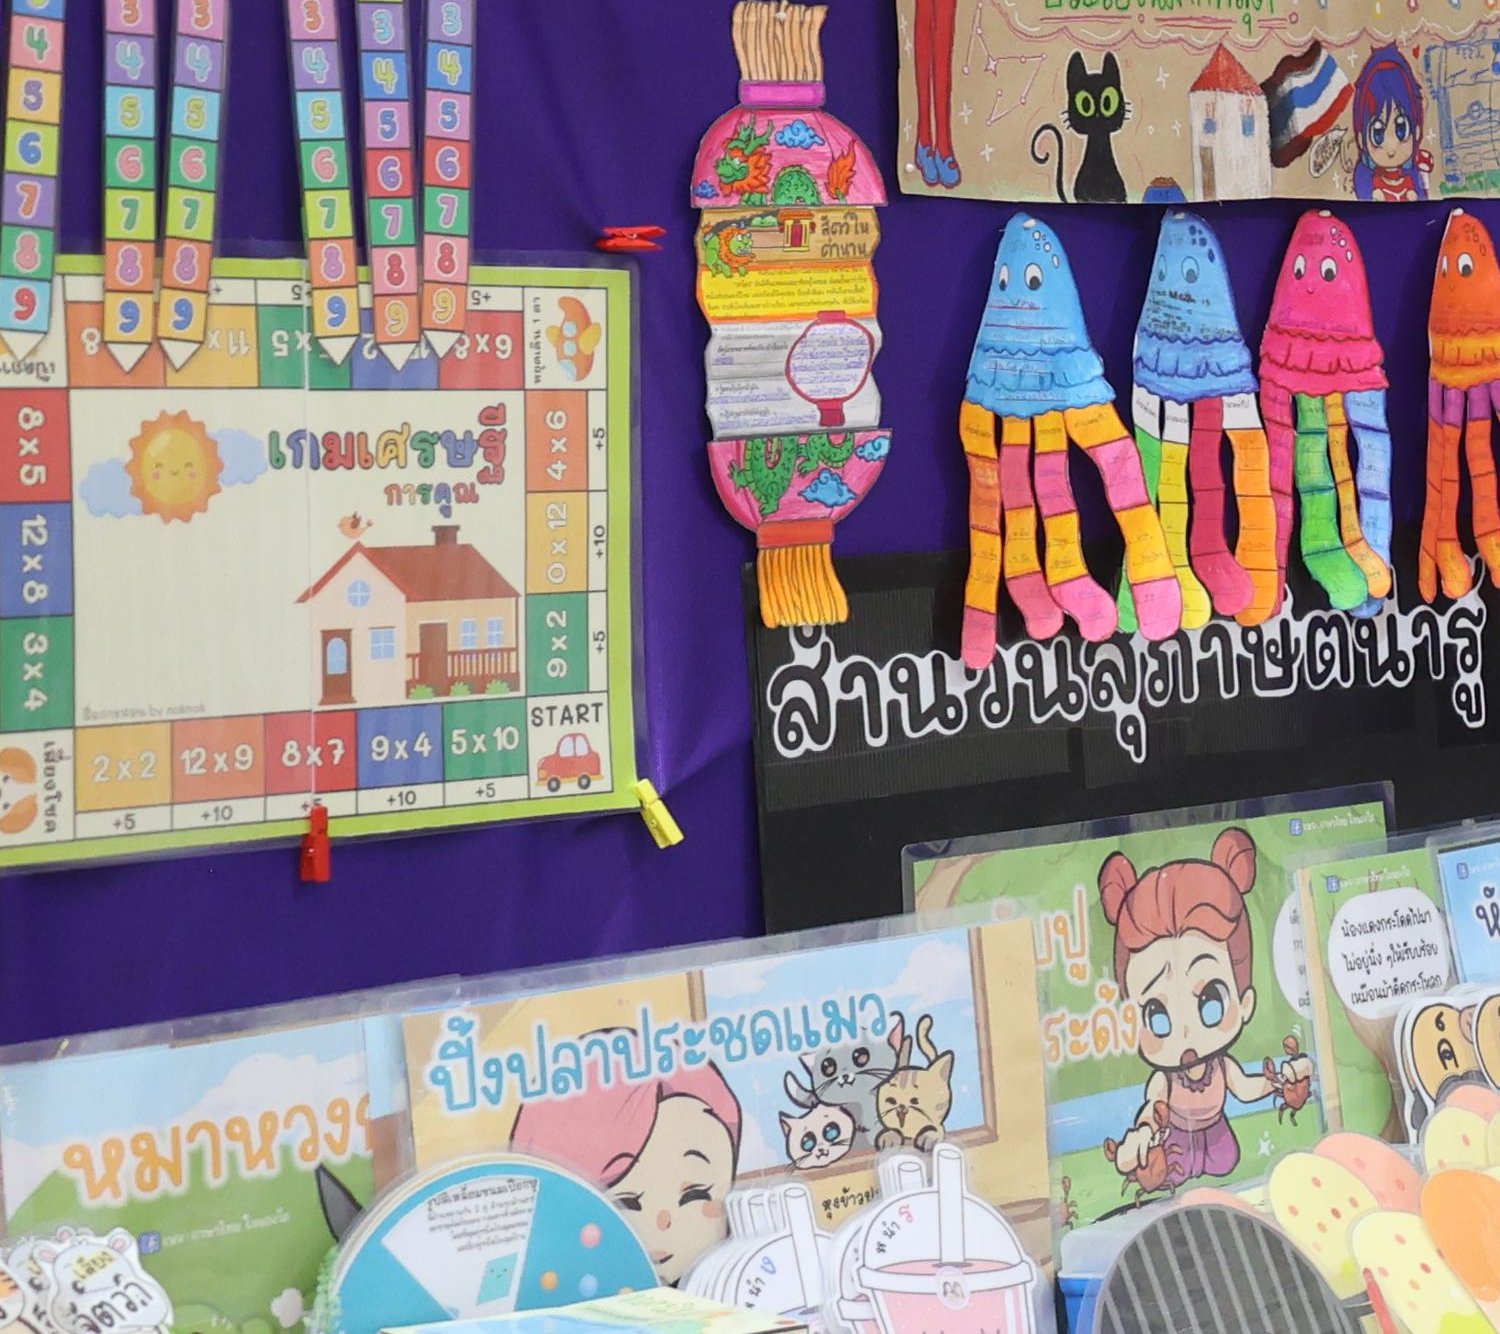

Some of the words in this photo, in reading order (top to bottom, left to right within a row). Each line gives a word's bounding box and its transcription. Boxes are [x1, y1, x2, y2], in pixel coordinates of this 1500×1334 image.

[26, 27, 47, 58] 4
[23, 80, 44, 111] 5
[20, 133, 41, 164] 6
[19, 184, 40, 215] 7
[819, 205, 872, 241] สัตว์ใน
[17, 237, 39, 267] 8
[819, 233, 870, 259] ตำนาน
[14, 288, 35, 319] 9
[383, 480, 480, 519] การคูณ
[530, 702, 604, 729] START
[386, 790, 417, 807] +10
[474, 781, 496, 798] +5
[112, 813, 136, 831] +5
[200, 804, 233, 823] +10
[428, 989, 888, 1114] ปิ้งปลาประชดแมว
